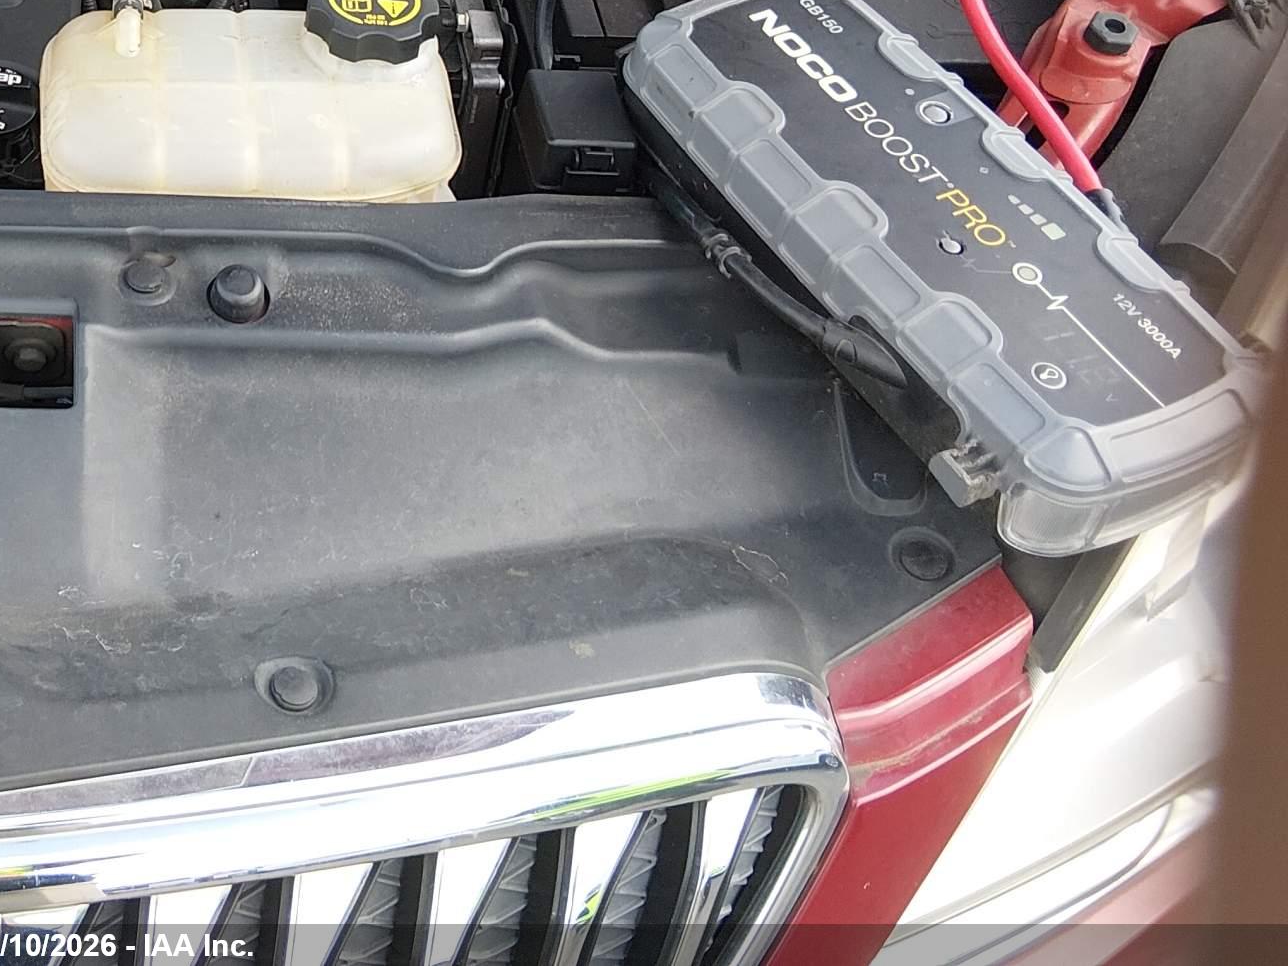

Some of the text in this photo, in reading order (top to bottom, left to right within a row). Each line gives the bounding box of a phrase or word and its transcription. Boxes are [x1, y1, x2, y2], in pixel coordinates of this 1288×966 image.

[748, 8, 1006, 247] NOCO BOOST PRO
[1112, 293, 1182, 359] 12V 3000A
